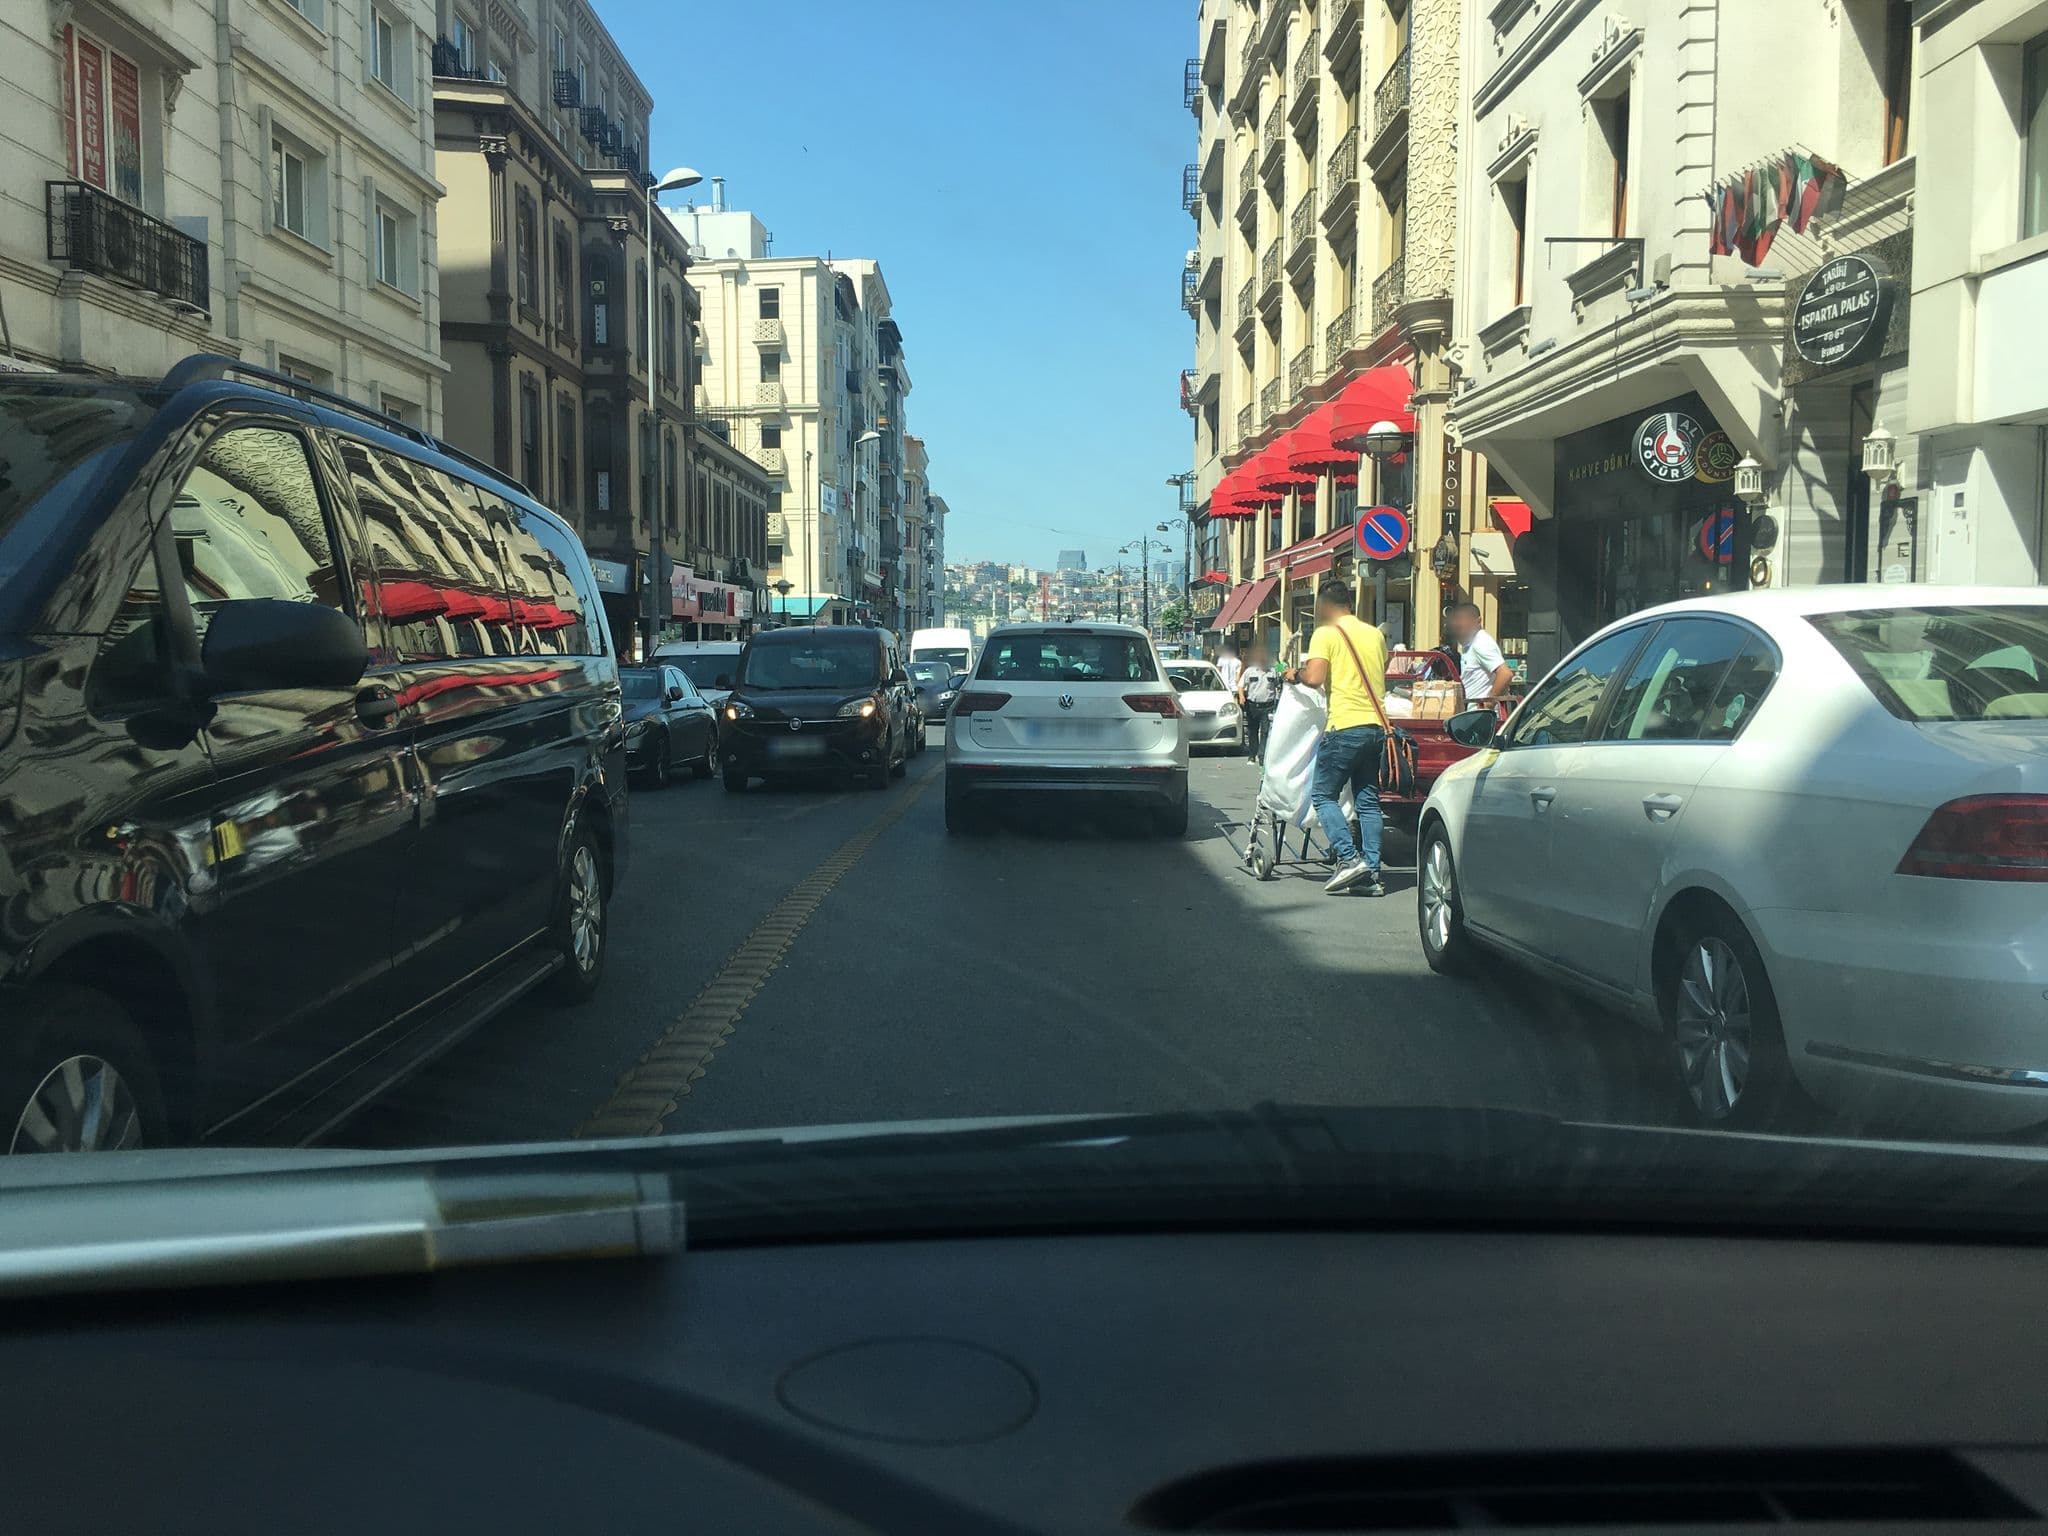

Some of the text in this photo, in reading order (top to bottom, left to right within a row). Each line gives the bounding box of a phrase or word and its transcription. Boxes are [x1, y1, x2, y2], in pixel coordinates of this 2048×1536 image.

[1801, 290, 1870, 331] ISPARTA PALAS
[1680, 419, 1698, 438] AL
[1643, 436, 1680, 478] GÖTÜR
